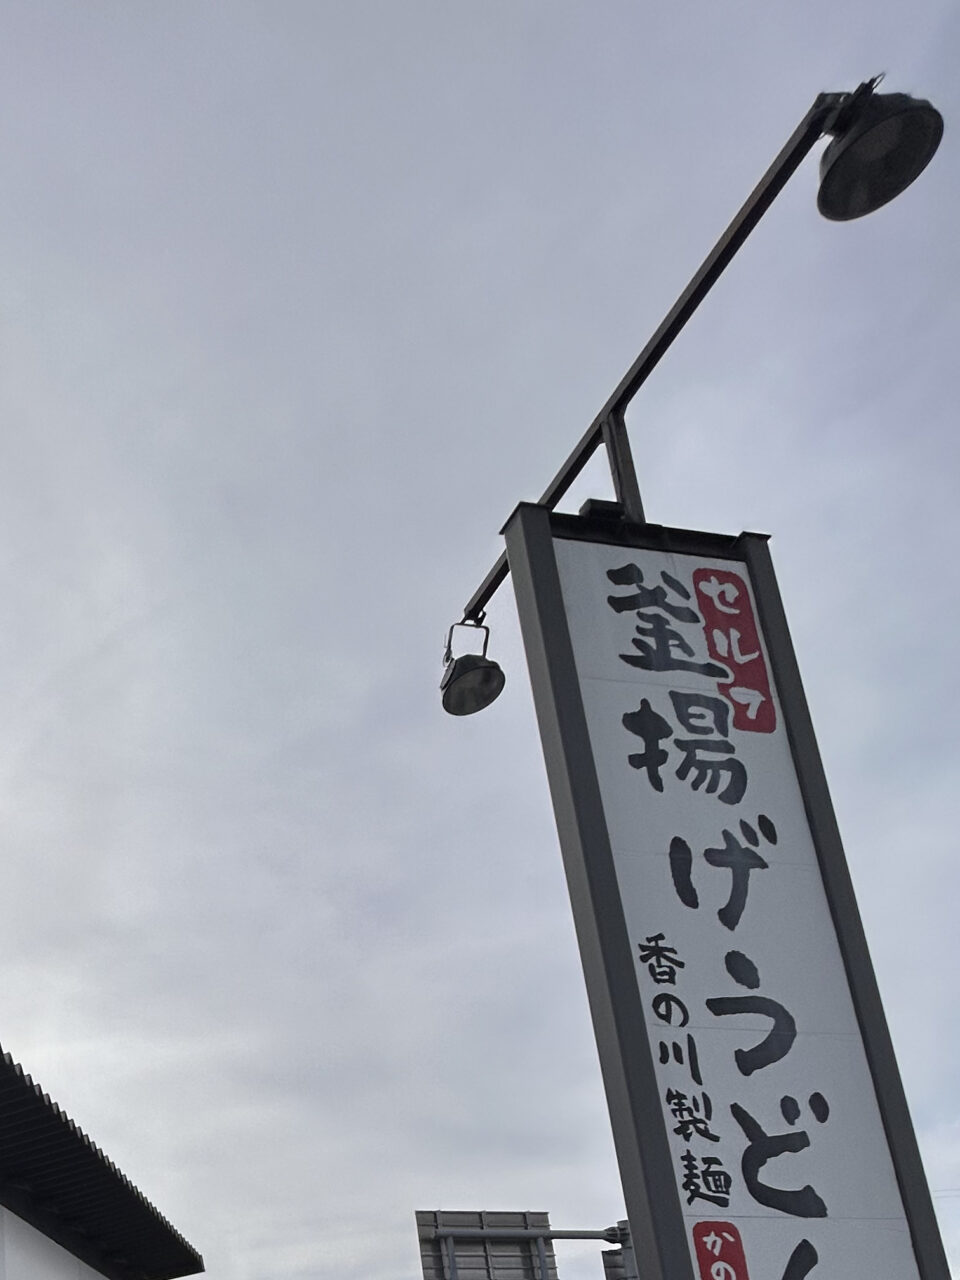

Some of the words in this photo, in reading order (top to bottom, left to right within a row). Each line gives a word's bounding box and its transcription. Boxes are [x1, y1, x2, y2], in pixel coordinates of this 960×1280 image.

[699, 575, 766, 721] セルフ
[638, 932, 732, 1207] 香の川製麺
